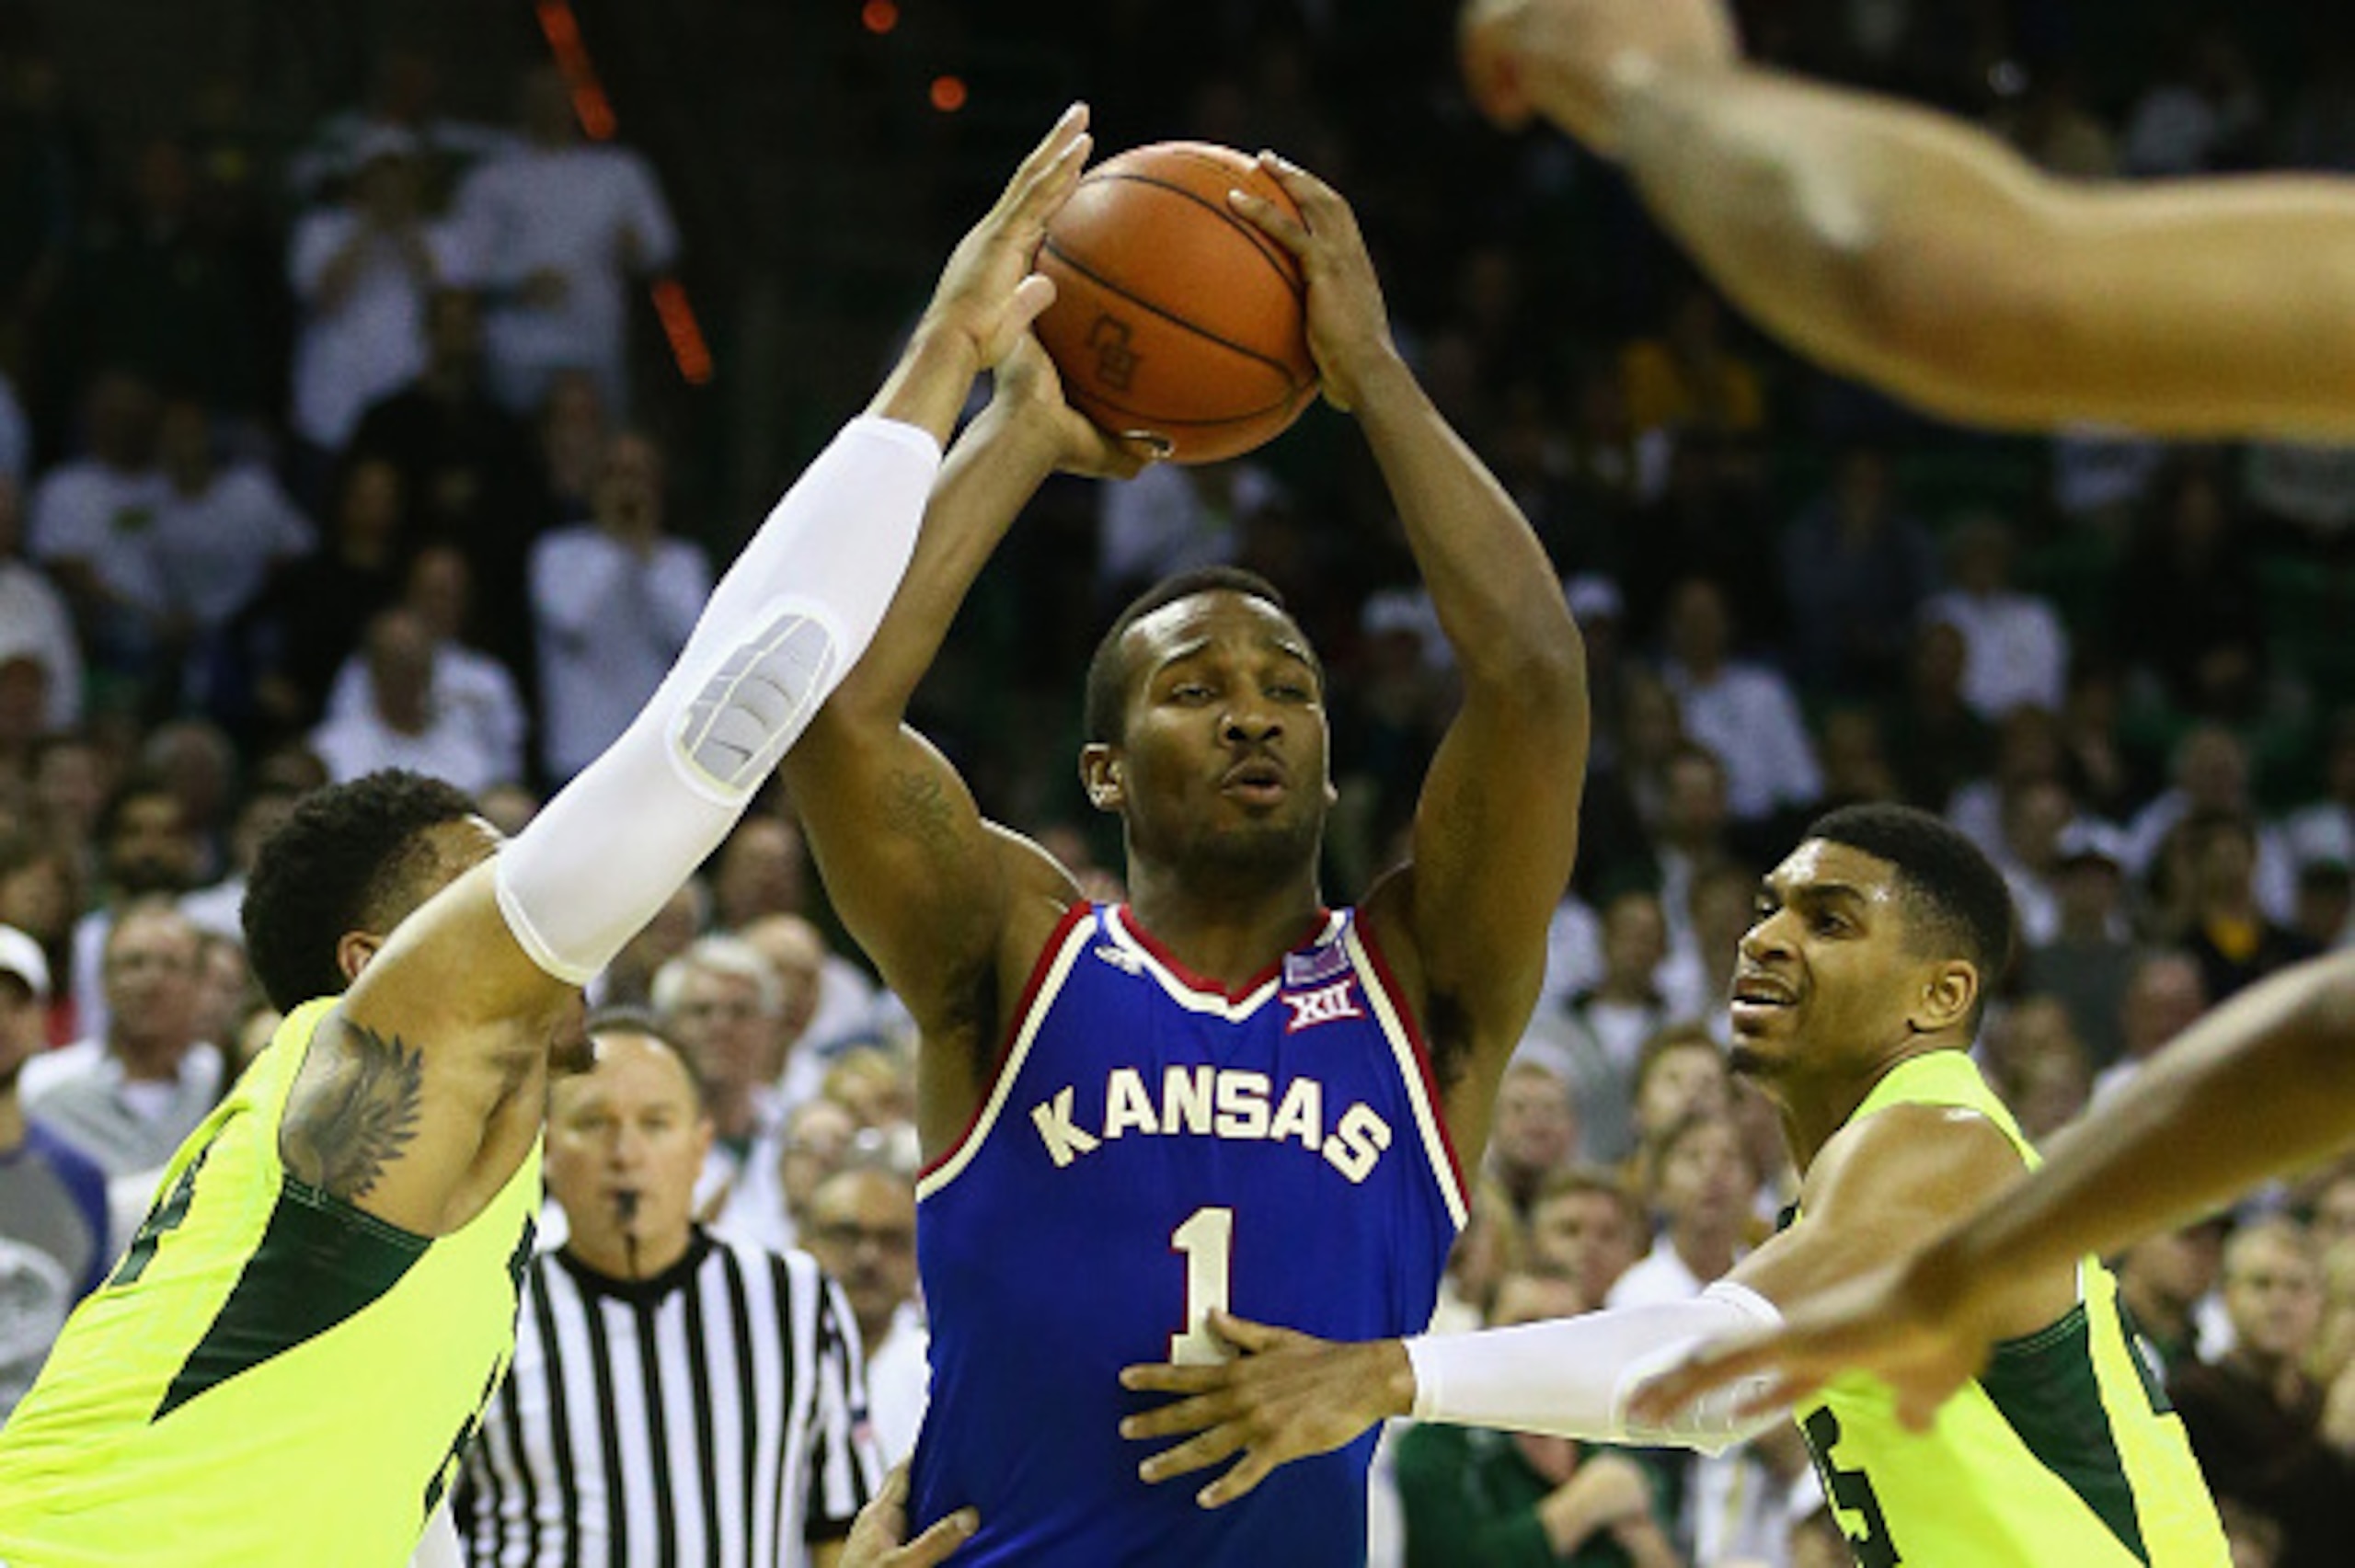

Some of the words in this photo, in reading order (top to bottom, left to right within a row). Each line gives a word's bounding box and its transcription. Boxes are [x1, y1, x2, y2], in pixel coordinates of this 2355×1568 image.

[1281, 979, 1363, 1030] XII
[1030, 1064, 1393, 1185] KANSAS
[1169, 1207, 1238, 1366] 1
